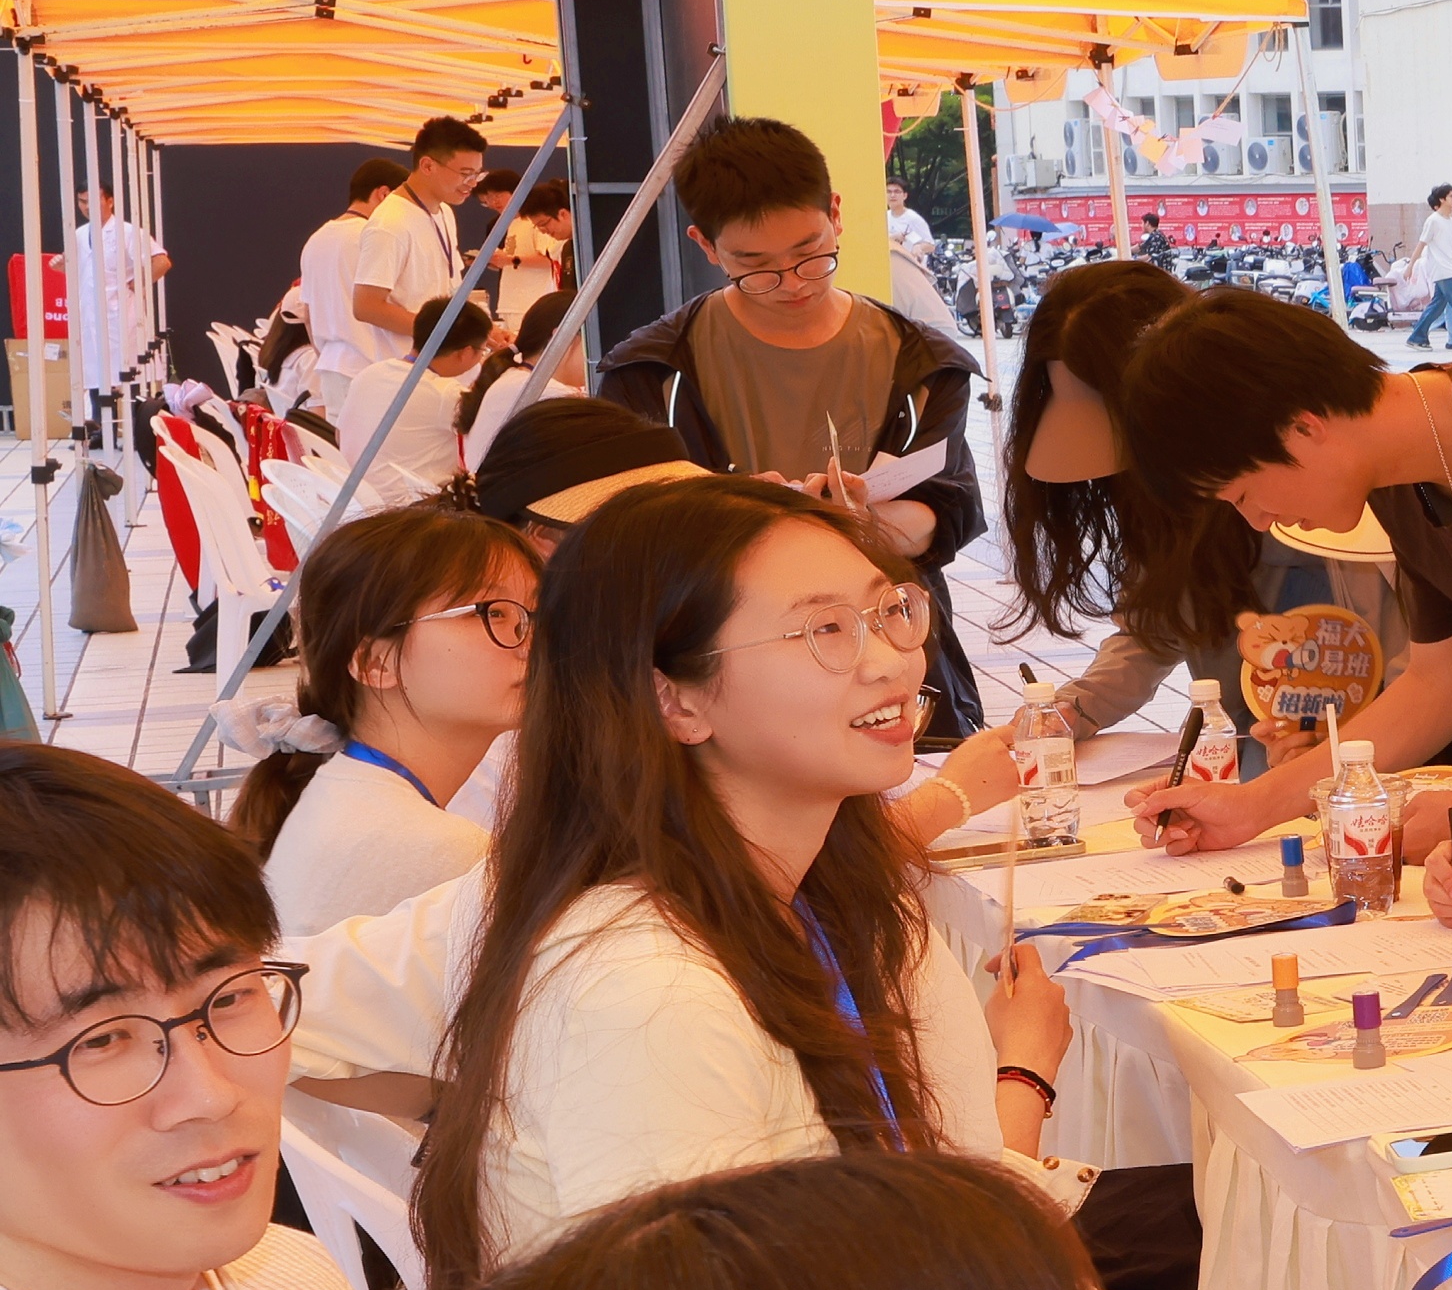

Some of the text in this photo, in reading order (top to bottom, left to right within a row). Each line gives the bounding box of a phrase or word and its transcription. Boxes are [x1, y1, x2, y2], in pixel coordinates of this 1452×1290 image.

[1316, 617, 1368, 647] 福大
[1319, 650, 1372, 679] 易班
[1277, 691, 1346, 717] 招新啦
